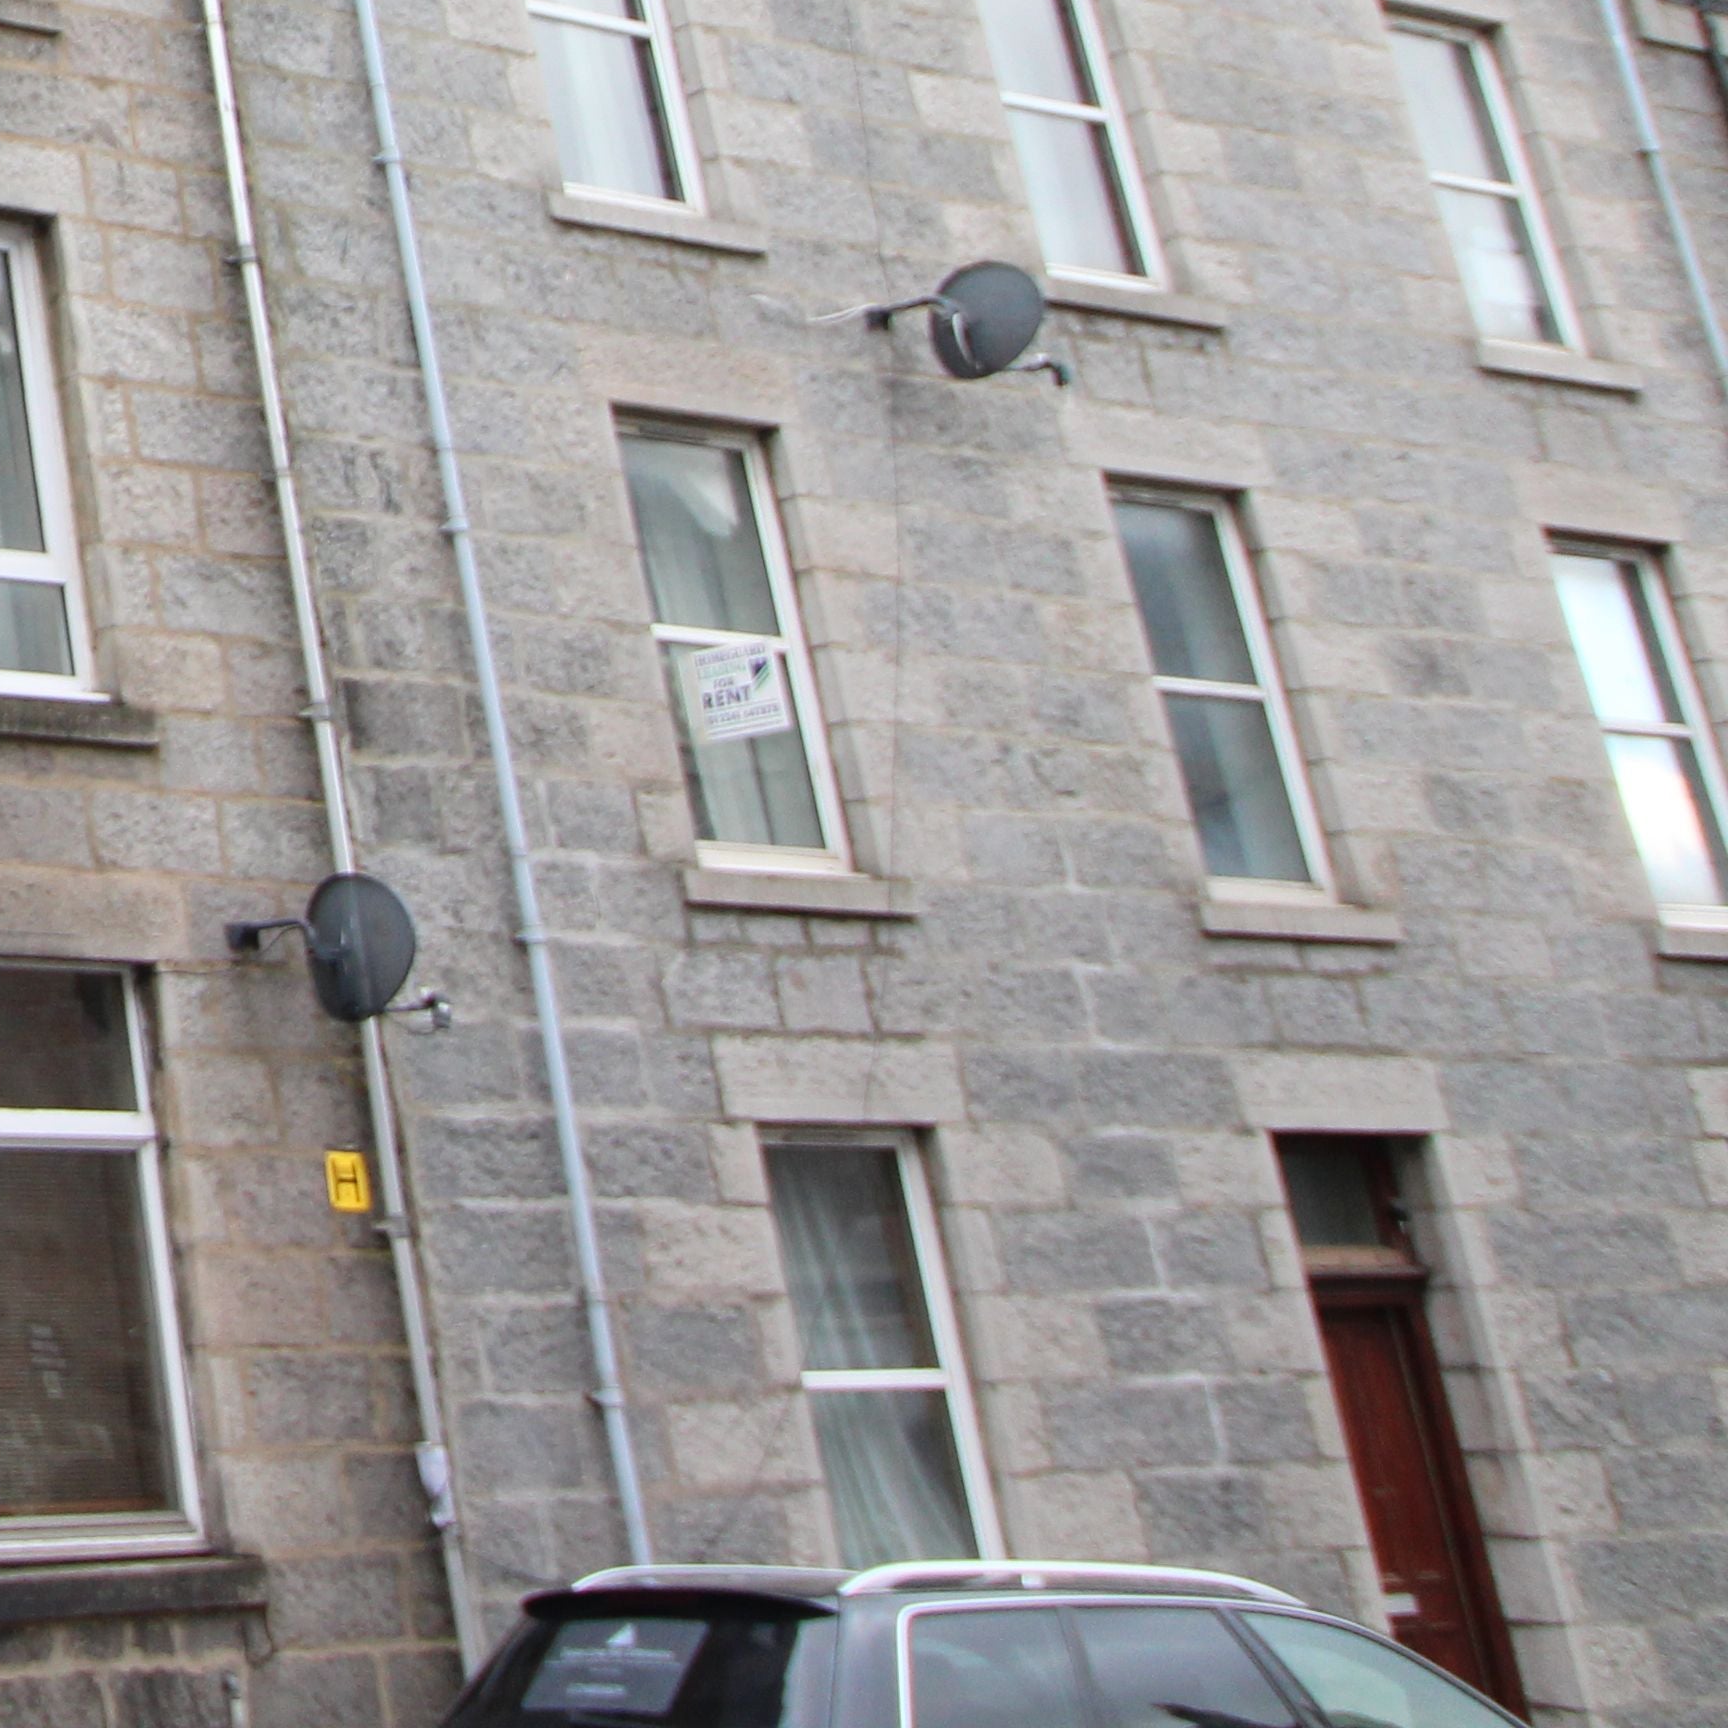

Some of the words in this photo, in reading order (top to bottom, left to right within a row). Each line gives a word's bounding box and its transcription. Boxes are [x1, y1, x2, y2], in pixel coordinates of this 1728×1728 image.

[713, 677, 734, 689] FOR
[703, 684, 751, 709] RENT
[330, 1158, 360, 1203] H
